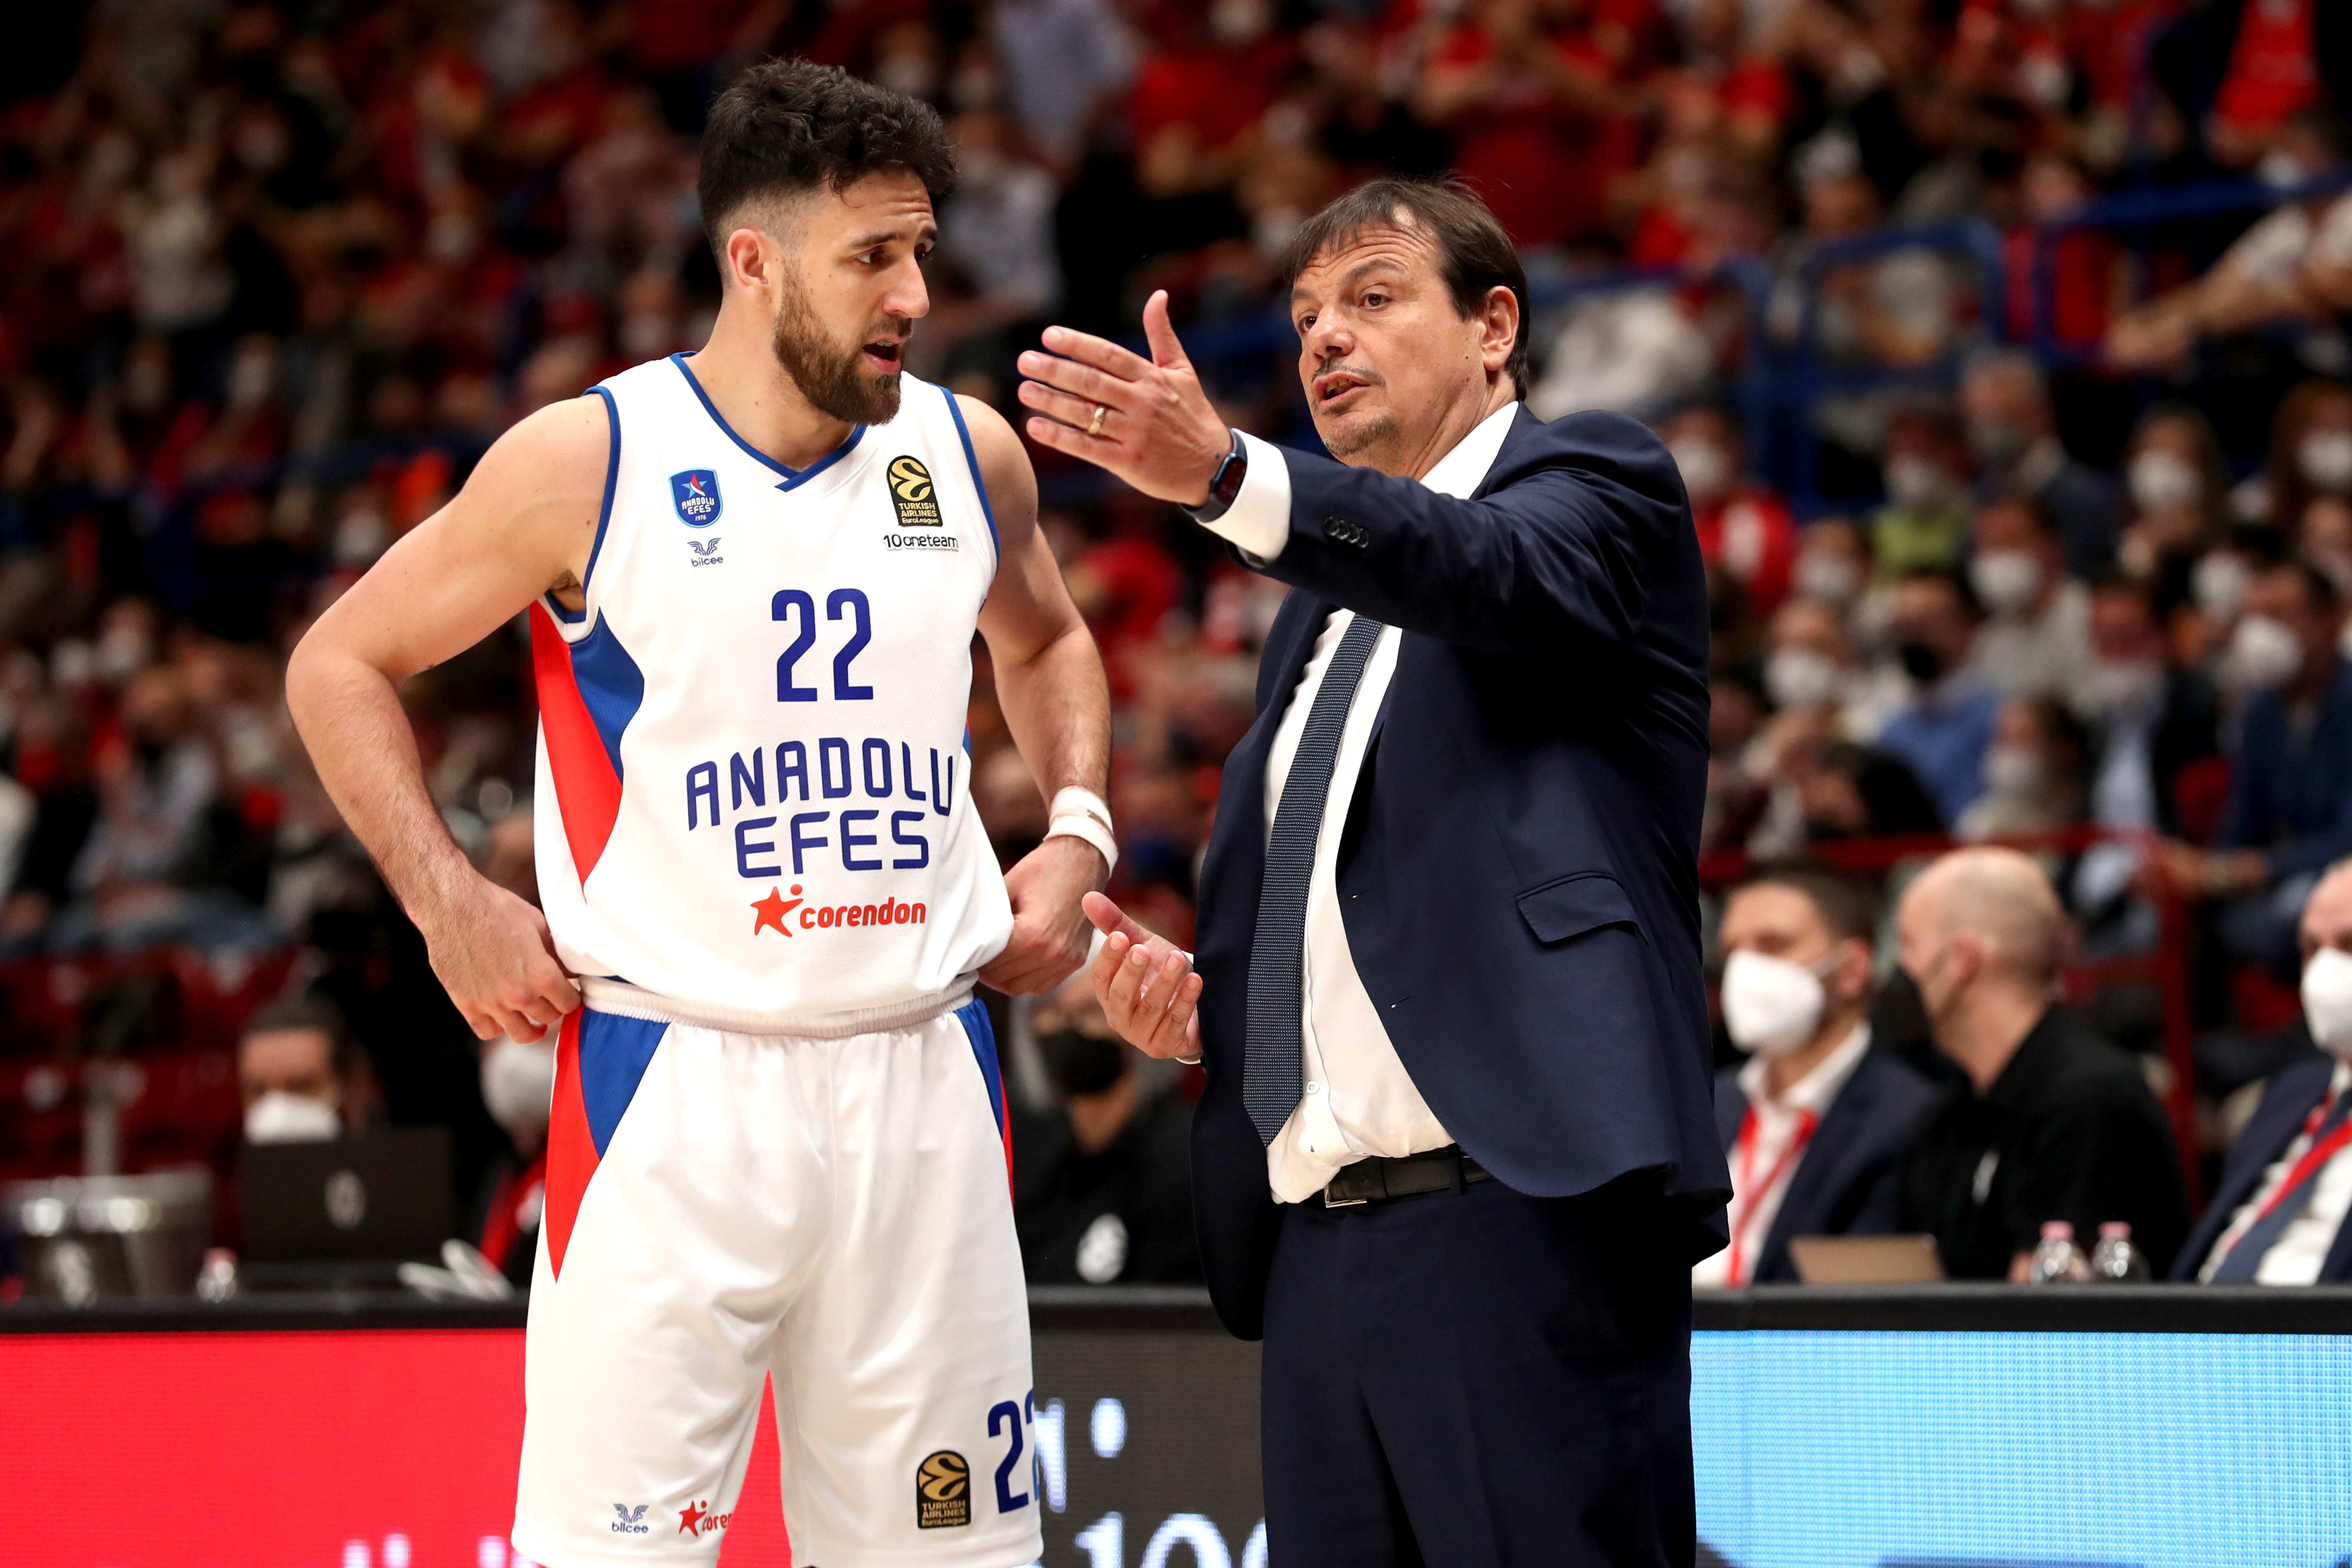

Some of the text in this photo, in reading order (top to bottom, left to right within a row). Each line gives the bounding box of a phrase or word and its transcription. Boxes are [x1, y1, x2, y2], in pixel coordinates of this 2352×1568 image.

[681, 497, 714, 510] ANADOLU
[688, 505, 711, 514] EFES
[691, 557, 723, 567] bilcee
[771, 588, 874, 702] 22
[686, 737, 953, 831] ANADOLU
[734, 809, 930, 878] EFES
[800, 896, 927, 927] corendon
[921, 1500, 966, 1511] TURKISH
[921, 1509, 966, 1519] AIRLINES
